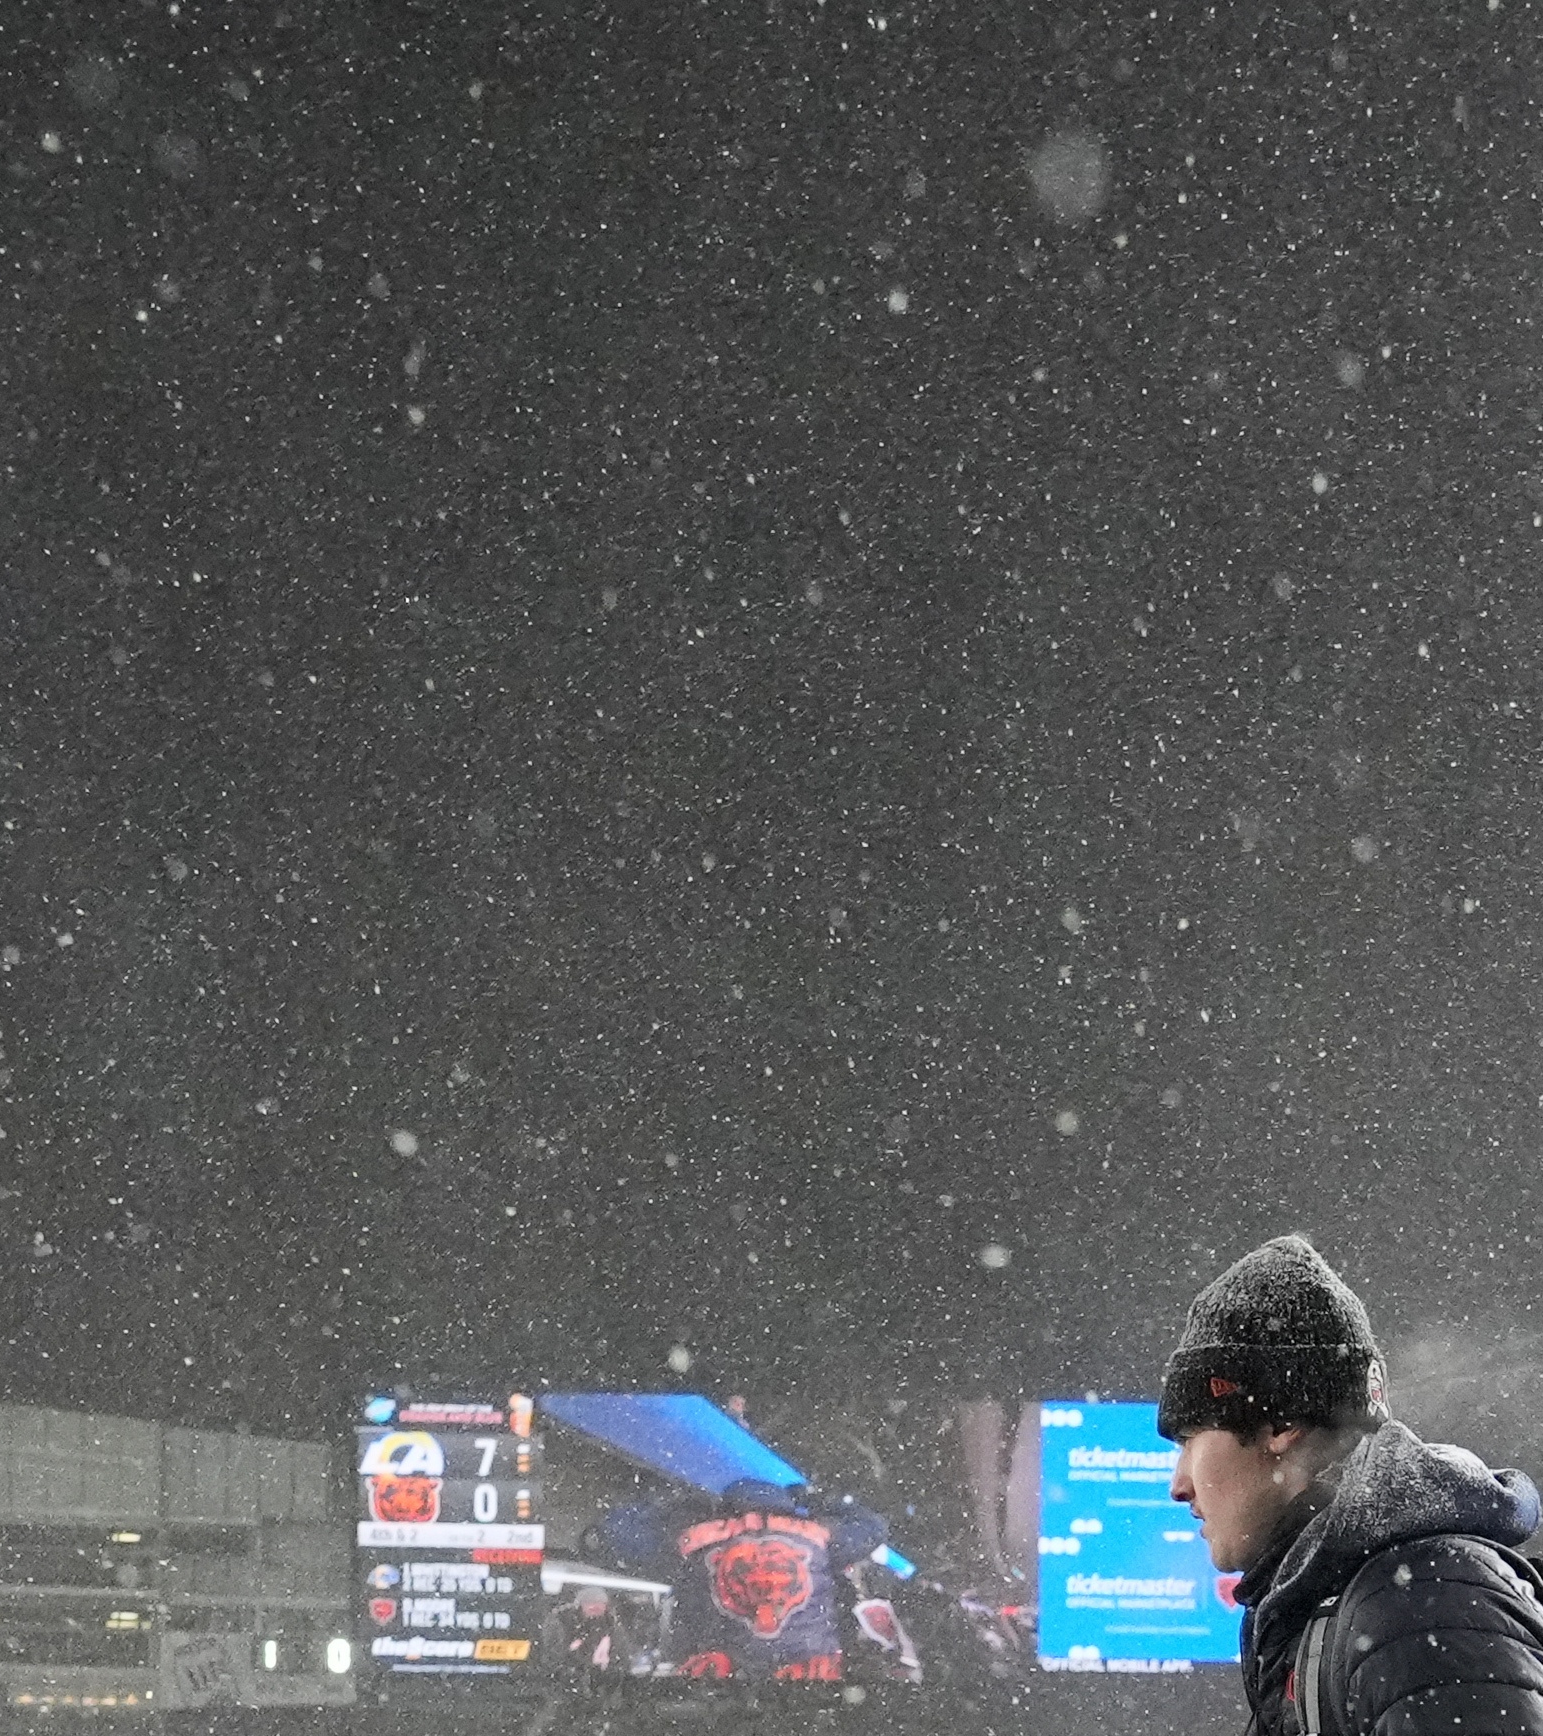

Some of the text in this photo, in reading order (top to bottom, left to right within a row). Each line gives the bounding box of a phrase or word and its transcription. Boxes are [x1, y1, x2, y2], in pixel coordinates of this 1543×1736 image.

[474, 1438, 498, 1477] 7
[473, 1483, 499, 1523] 0
[1066, 1574, 1197, 1596] ticketmaster
[327, 1638, 351, 1674] 0
